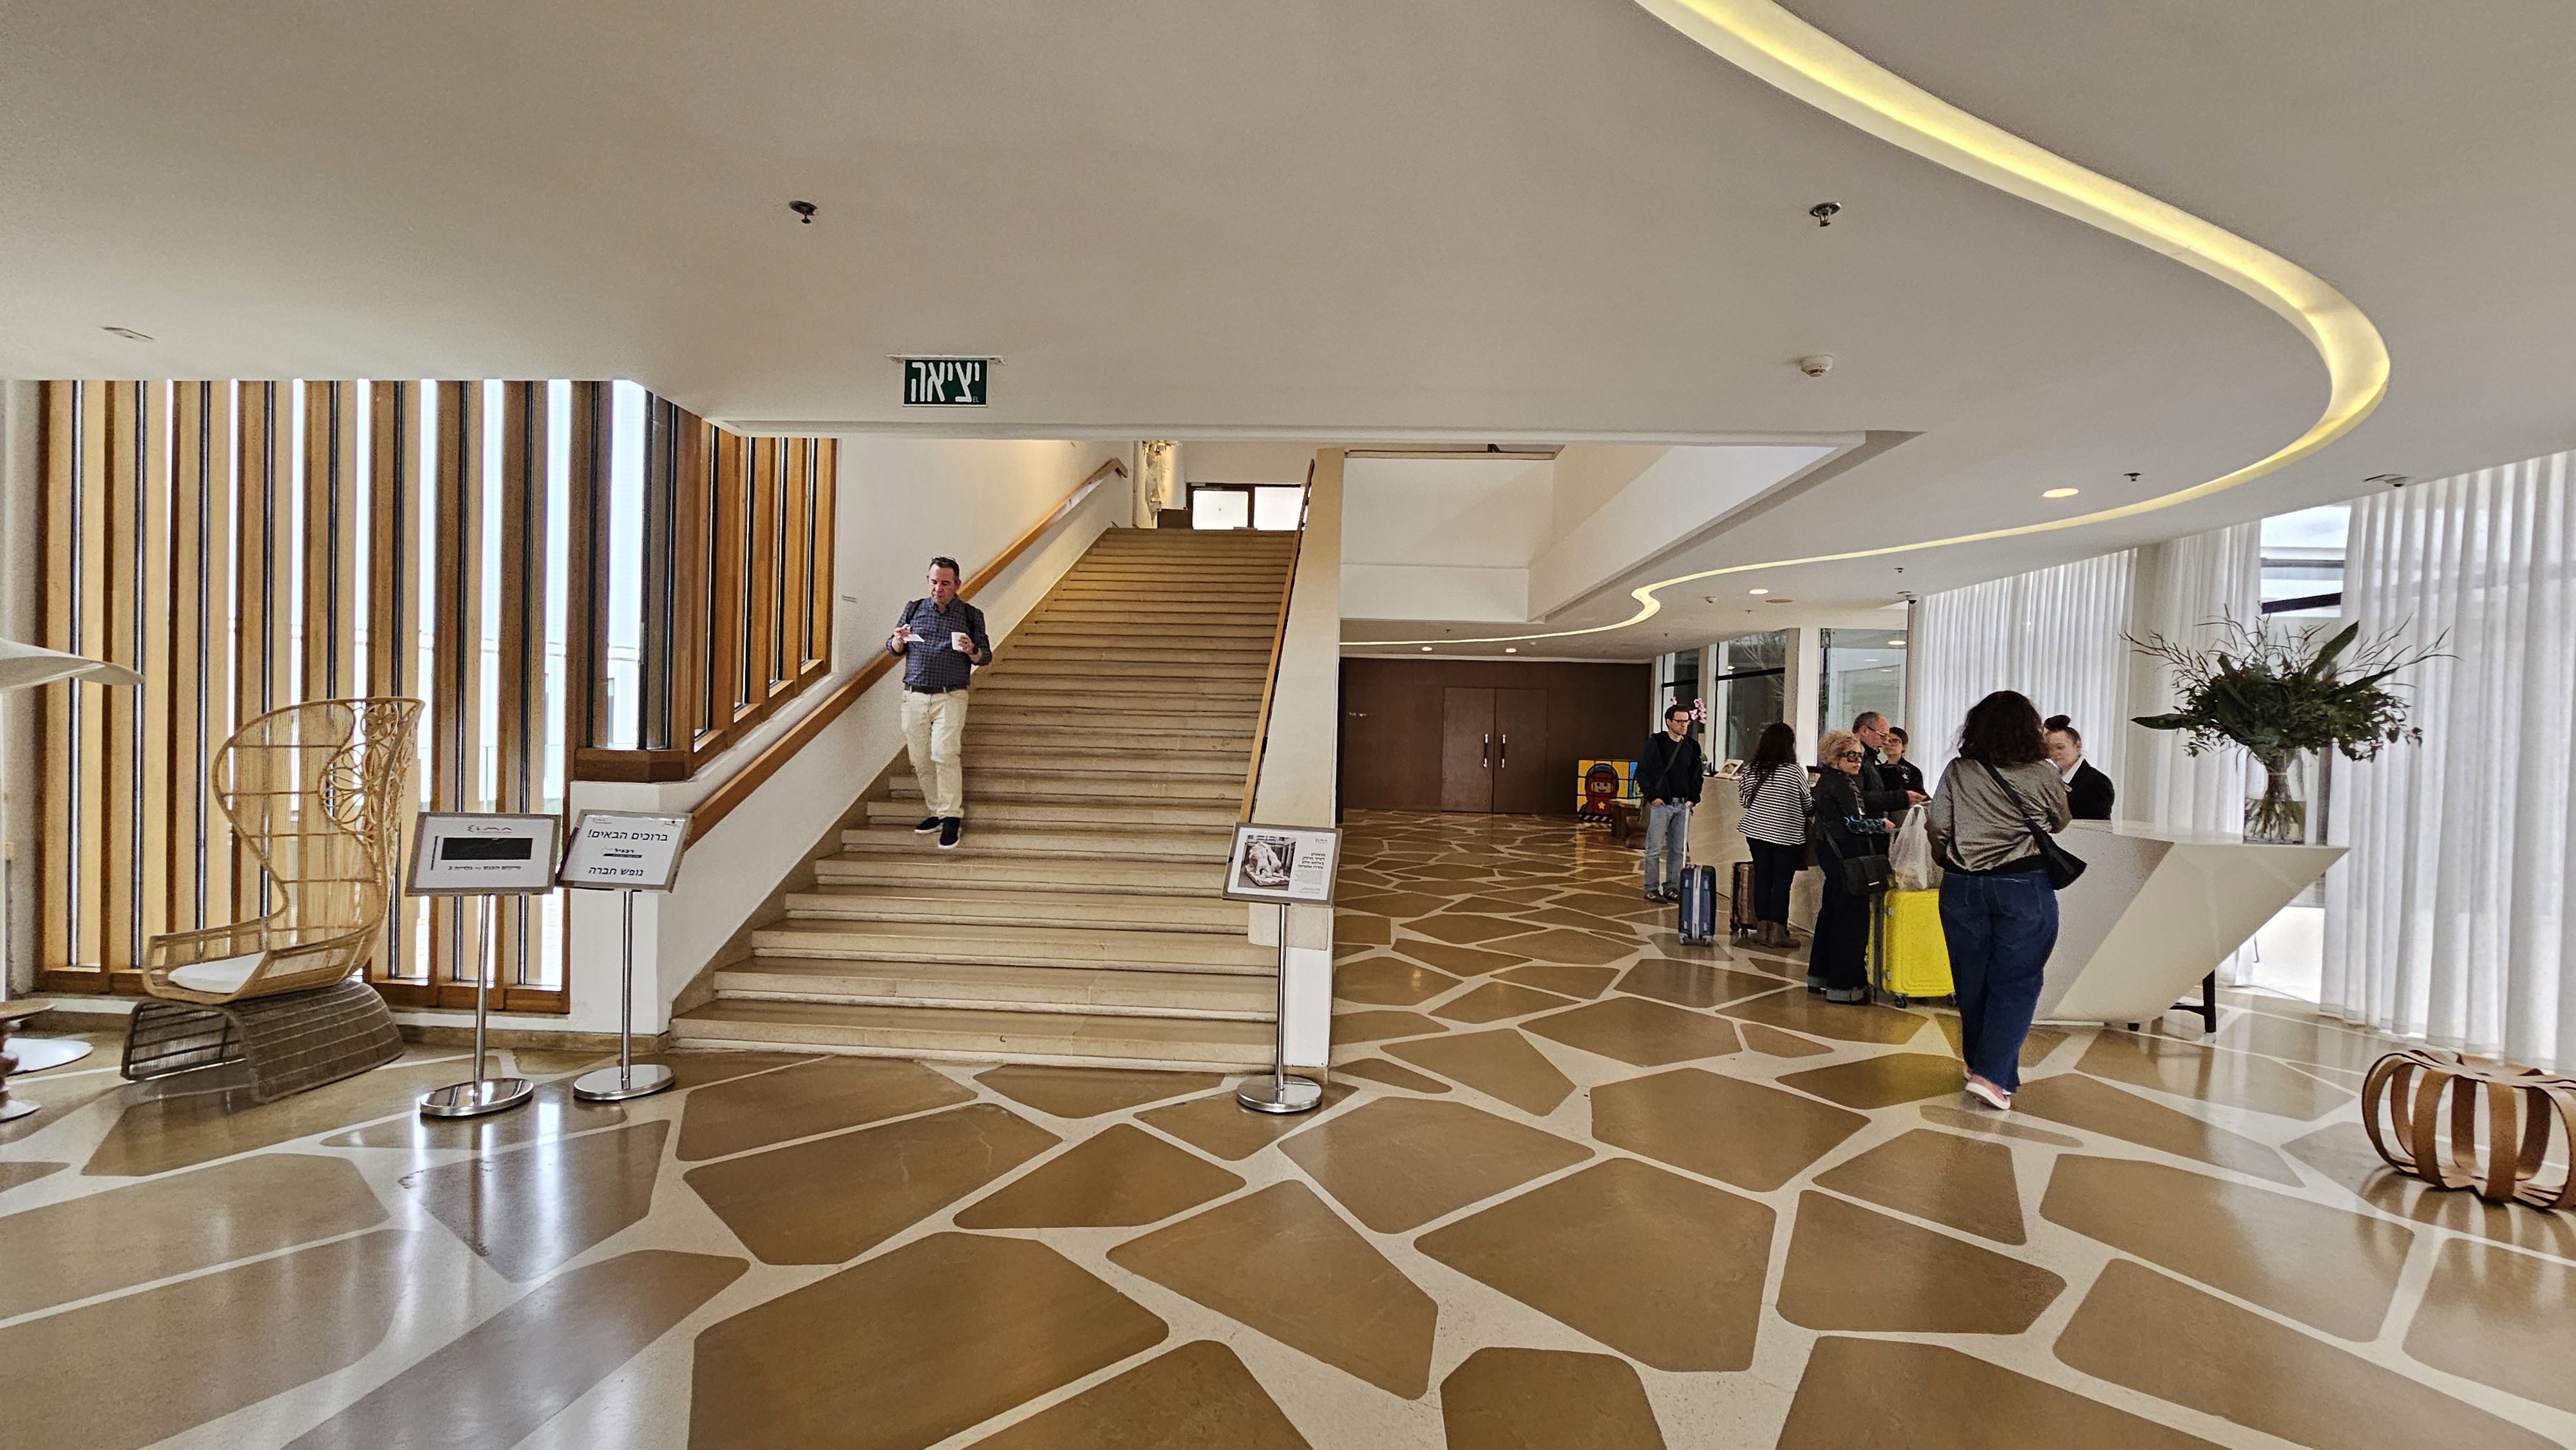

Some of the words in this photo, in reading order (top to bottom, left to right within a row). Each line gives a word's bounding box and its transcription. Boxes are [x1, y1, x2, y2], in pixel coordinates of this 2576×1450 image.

[911, 362, 980, 402] יציאה
[587, 829, 628, 840] הבאים!
[631, 831, 668, 842] ברוכים
[588, 867, 617, 875] חברה
[620, 868, 644, 876] נופש
